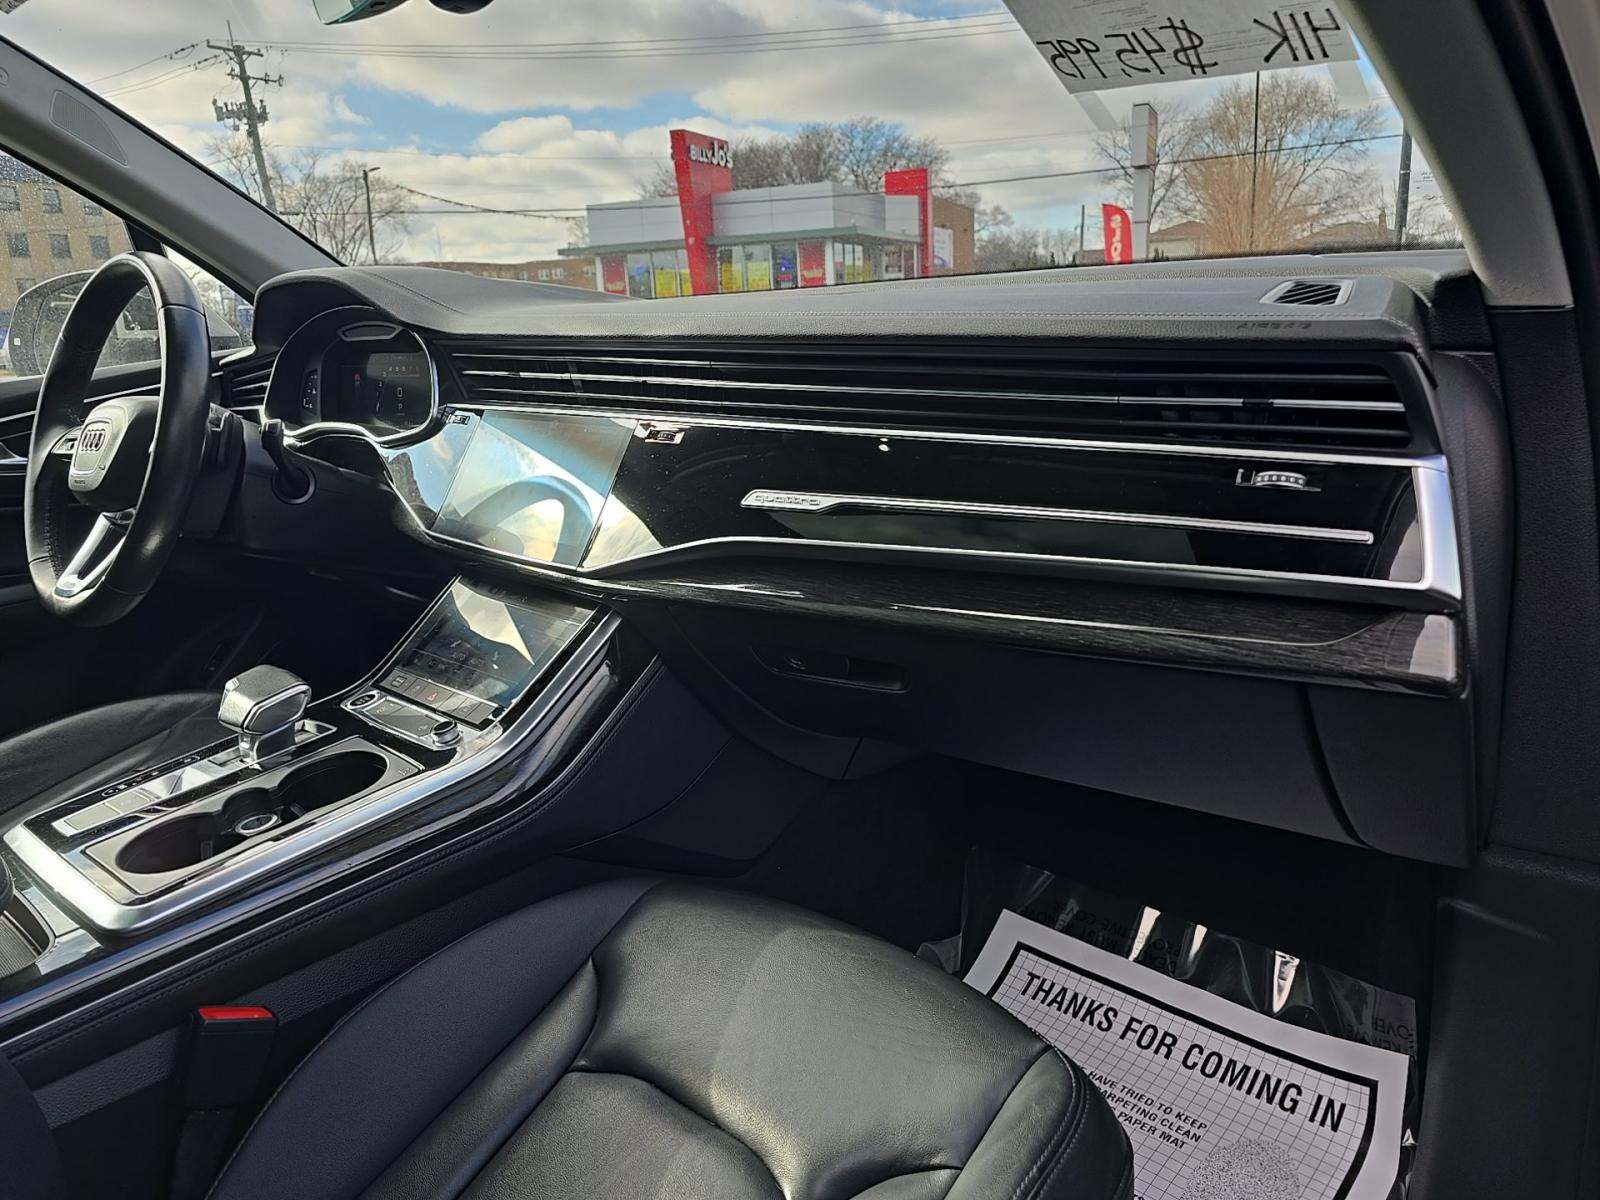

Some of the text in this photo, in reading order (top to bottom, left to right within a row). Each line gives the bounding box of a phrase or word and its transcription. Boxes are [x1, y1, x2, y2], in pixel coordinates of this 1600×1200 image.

[1020, 971, 1347, 1133] THANKS FOR COMING IN
[1088, 1070, 1208, 1130] HAVE TRIED TO KEEP
[1098, 1087, 1202, 1143] ARPETING CLEAN
[1117, 1111, 1188, 1150] PAPER MAT
